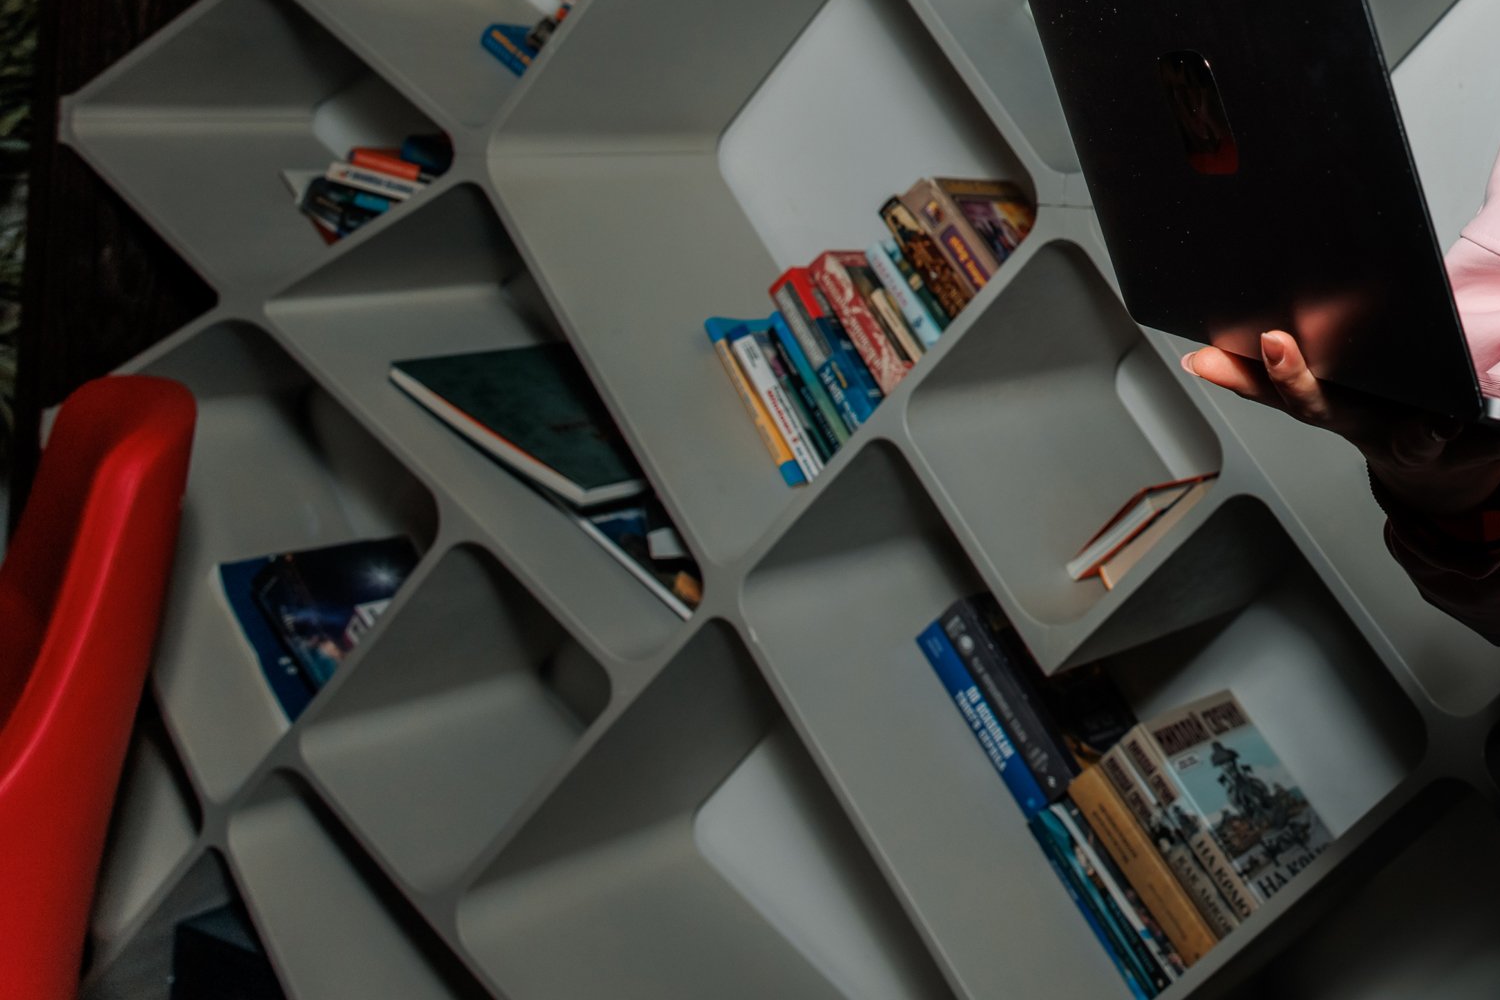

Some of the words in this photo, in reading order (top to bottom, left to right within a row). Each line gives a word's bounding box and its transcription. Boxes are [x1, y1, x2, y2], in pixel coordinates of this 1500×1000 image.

[1193, 838, 1219, 867] НА
[1212, 866, 1256, 918] КРАЮ
[1256, 866, 1290, 899] НА
